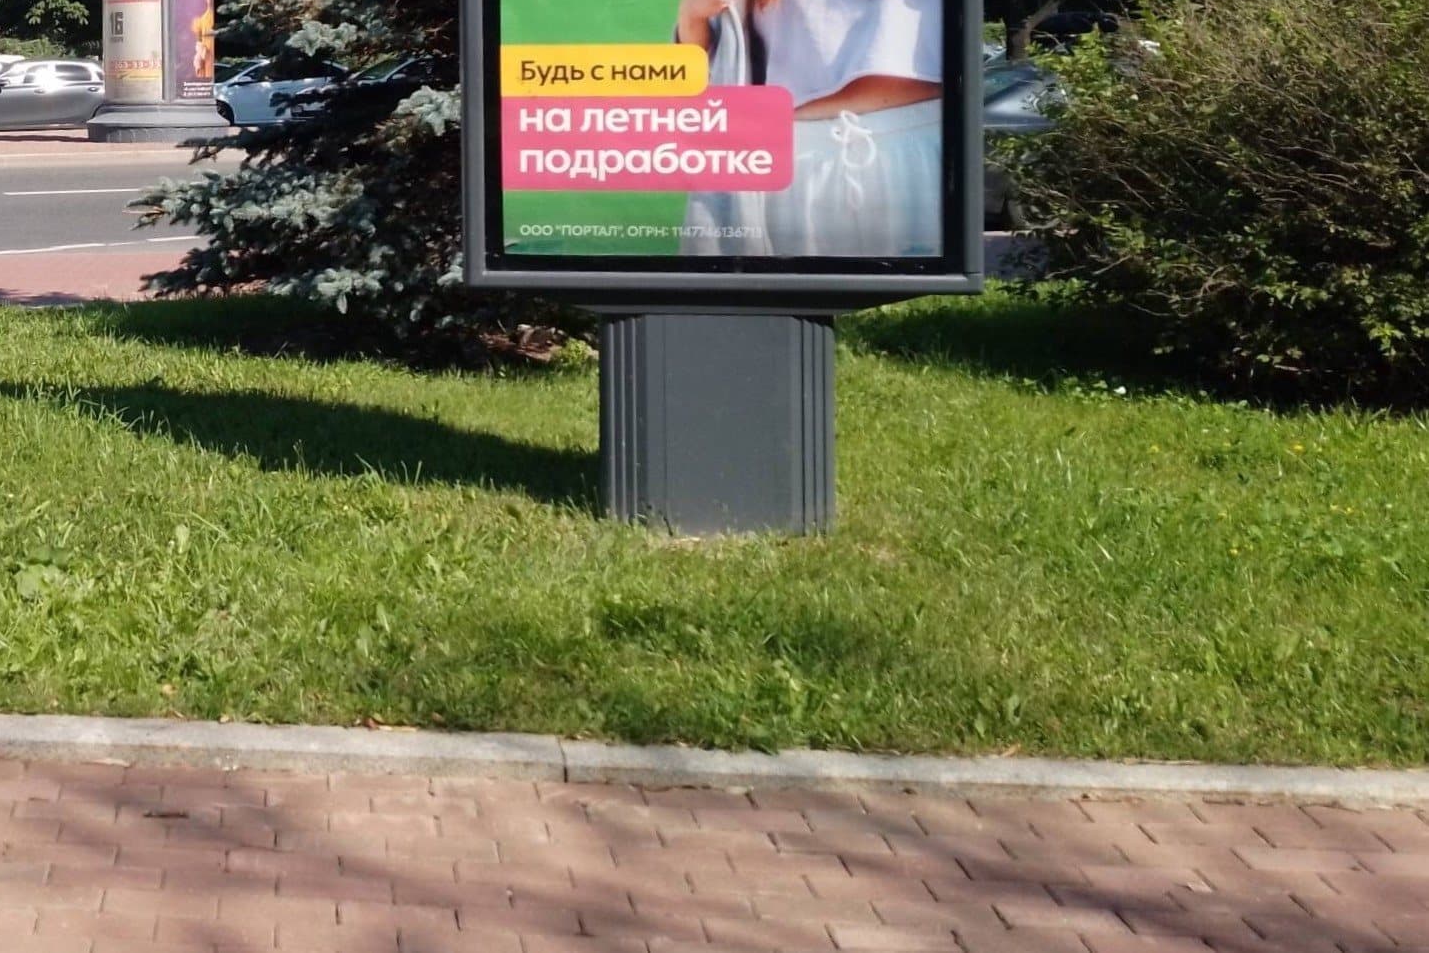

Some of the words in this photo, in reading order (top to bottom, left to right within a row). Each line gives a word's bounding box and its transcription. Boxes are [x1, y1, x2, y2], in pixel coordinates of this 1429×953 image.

[521, 60, 585, 86] Будь
[590, 64, 604, 81] с
[611, 63, 686, 81] нами
[520, 108, 571, 132] на
[580, 99, 727, 133] летней
[520, 142, 773, 181] подработке
[520, 224, 553, 237] ООО
